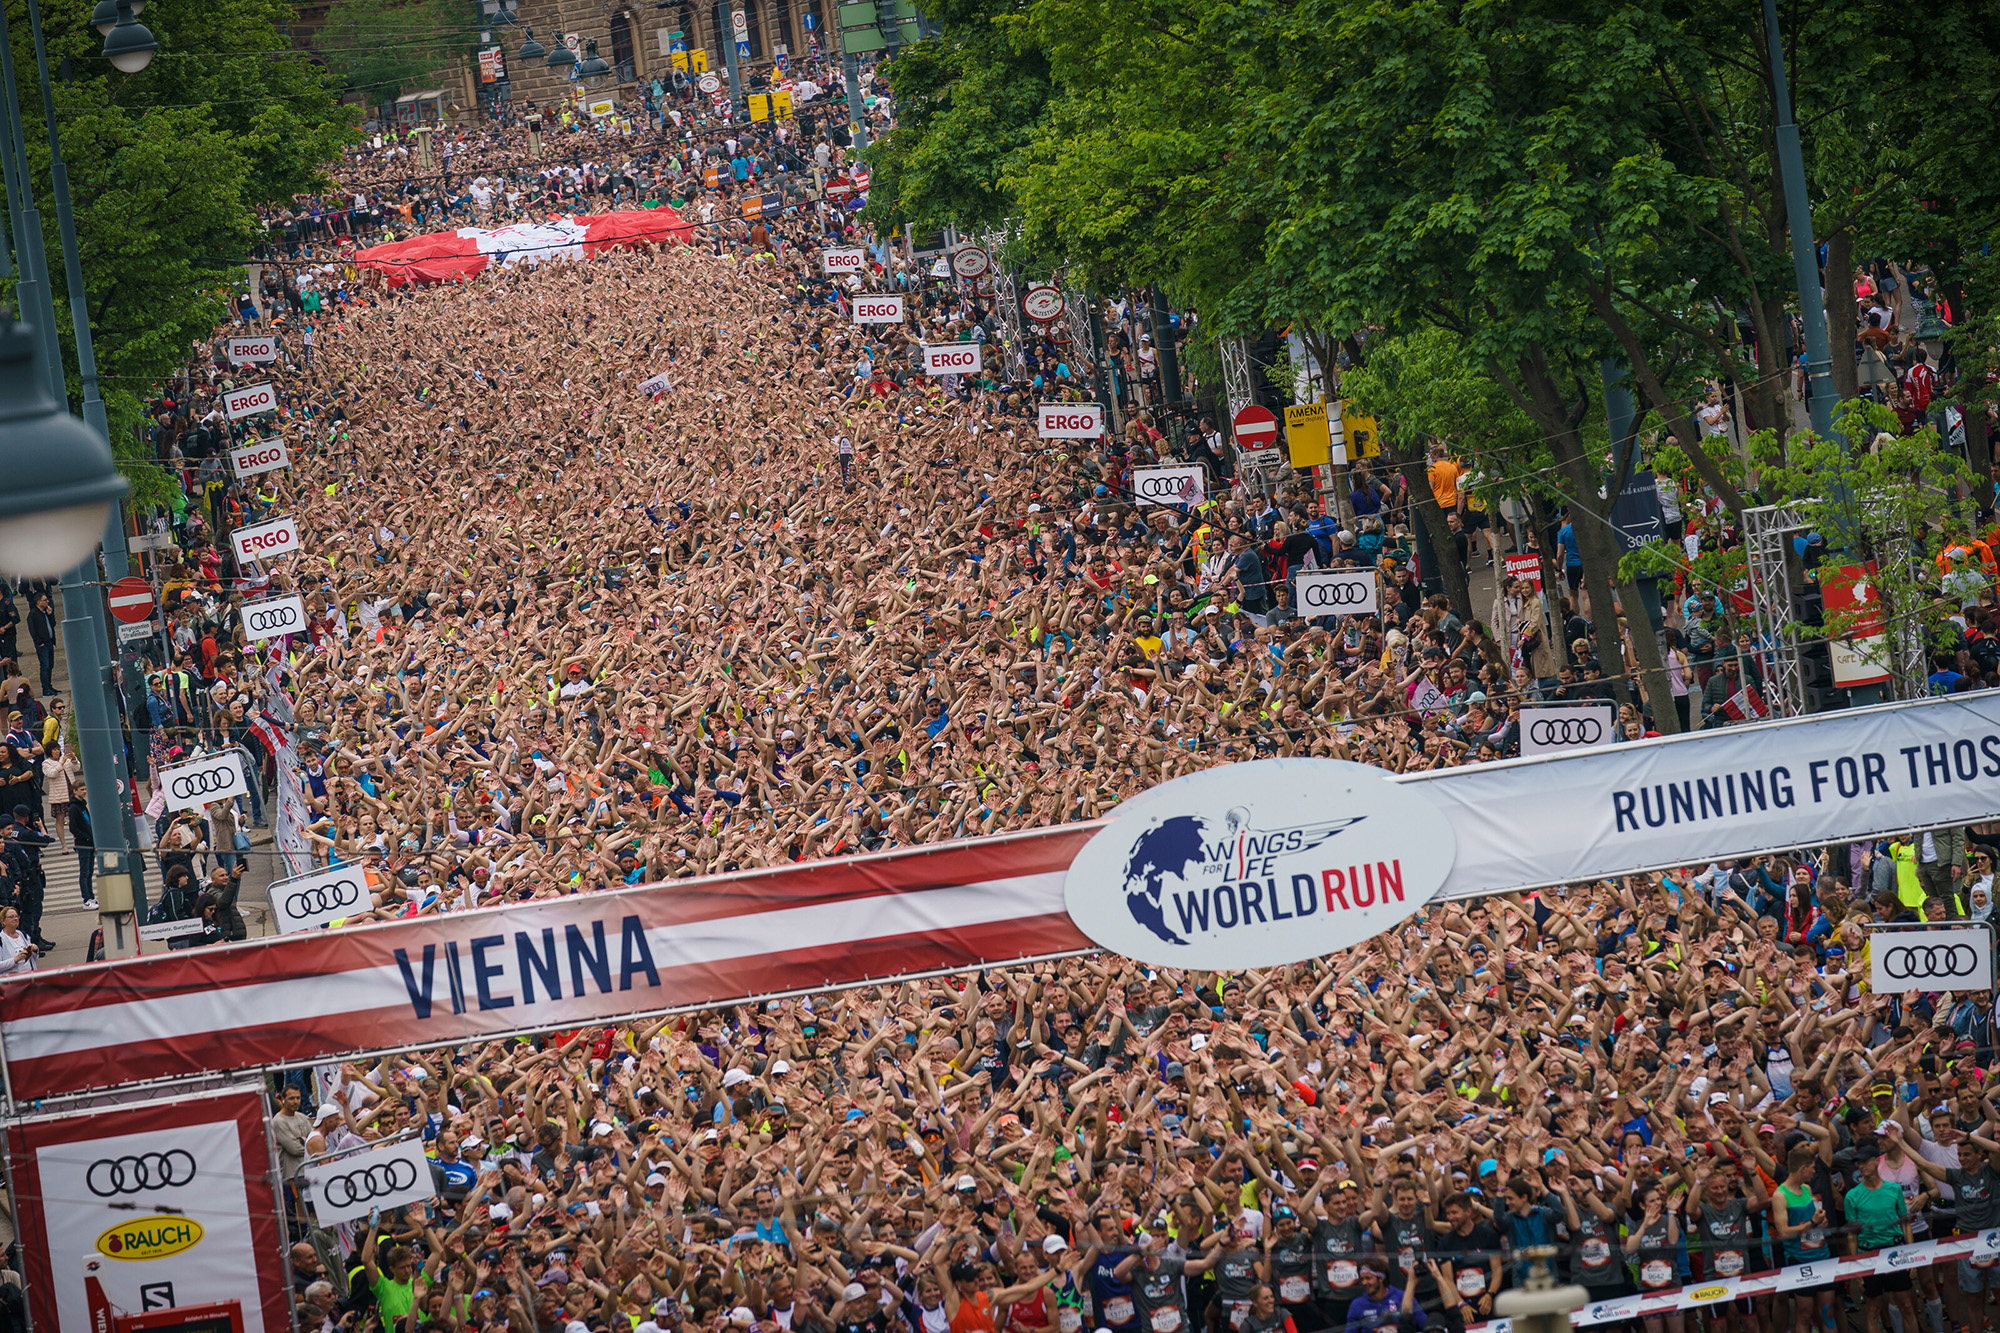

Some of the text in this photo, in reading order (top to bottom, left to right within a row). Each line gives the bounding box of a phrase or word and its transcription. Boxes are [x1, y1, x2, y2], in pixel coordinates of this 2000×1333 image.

[828, 255, 860, 267] ERGO
[858, 304, 898, 317] ERGO
[234, 344, 269, 356] ERGO
[931, 352, 975, 368] ERGO
[230, 392, 270, 411] ERGO
[1045, 414, 1094, 430] ERGO
[238, 448, 282, 469] ERGO
[241, 529, 290, 553] ERGO
[1506, 557, 1539, 572] Kronen
[1612, 766, 1796, 833] RUNNING
[1809, 752, 1890, 803] FOR
[1202, 864, 1223, 876] FOR
[393, 915, 662, 1020] VIENNA
[124, 1224, 192, 1251] RAUCH
[1699, 1287, 1725, 1299] RAUCH
